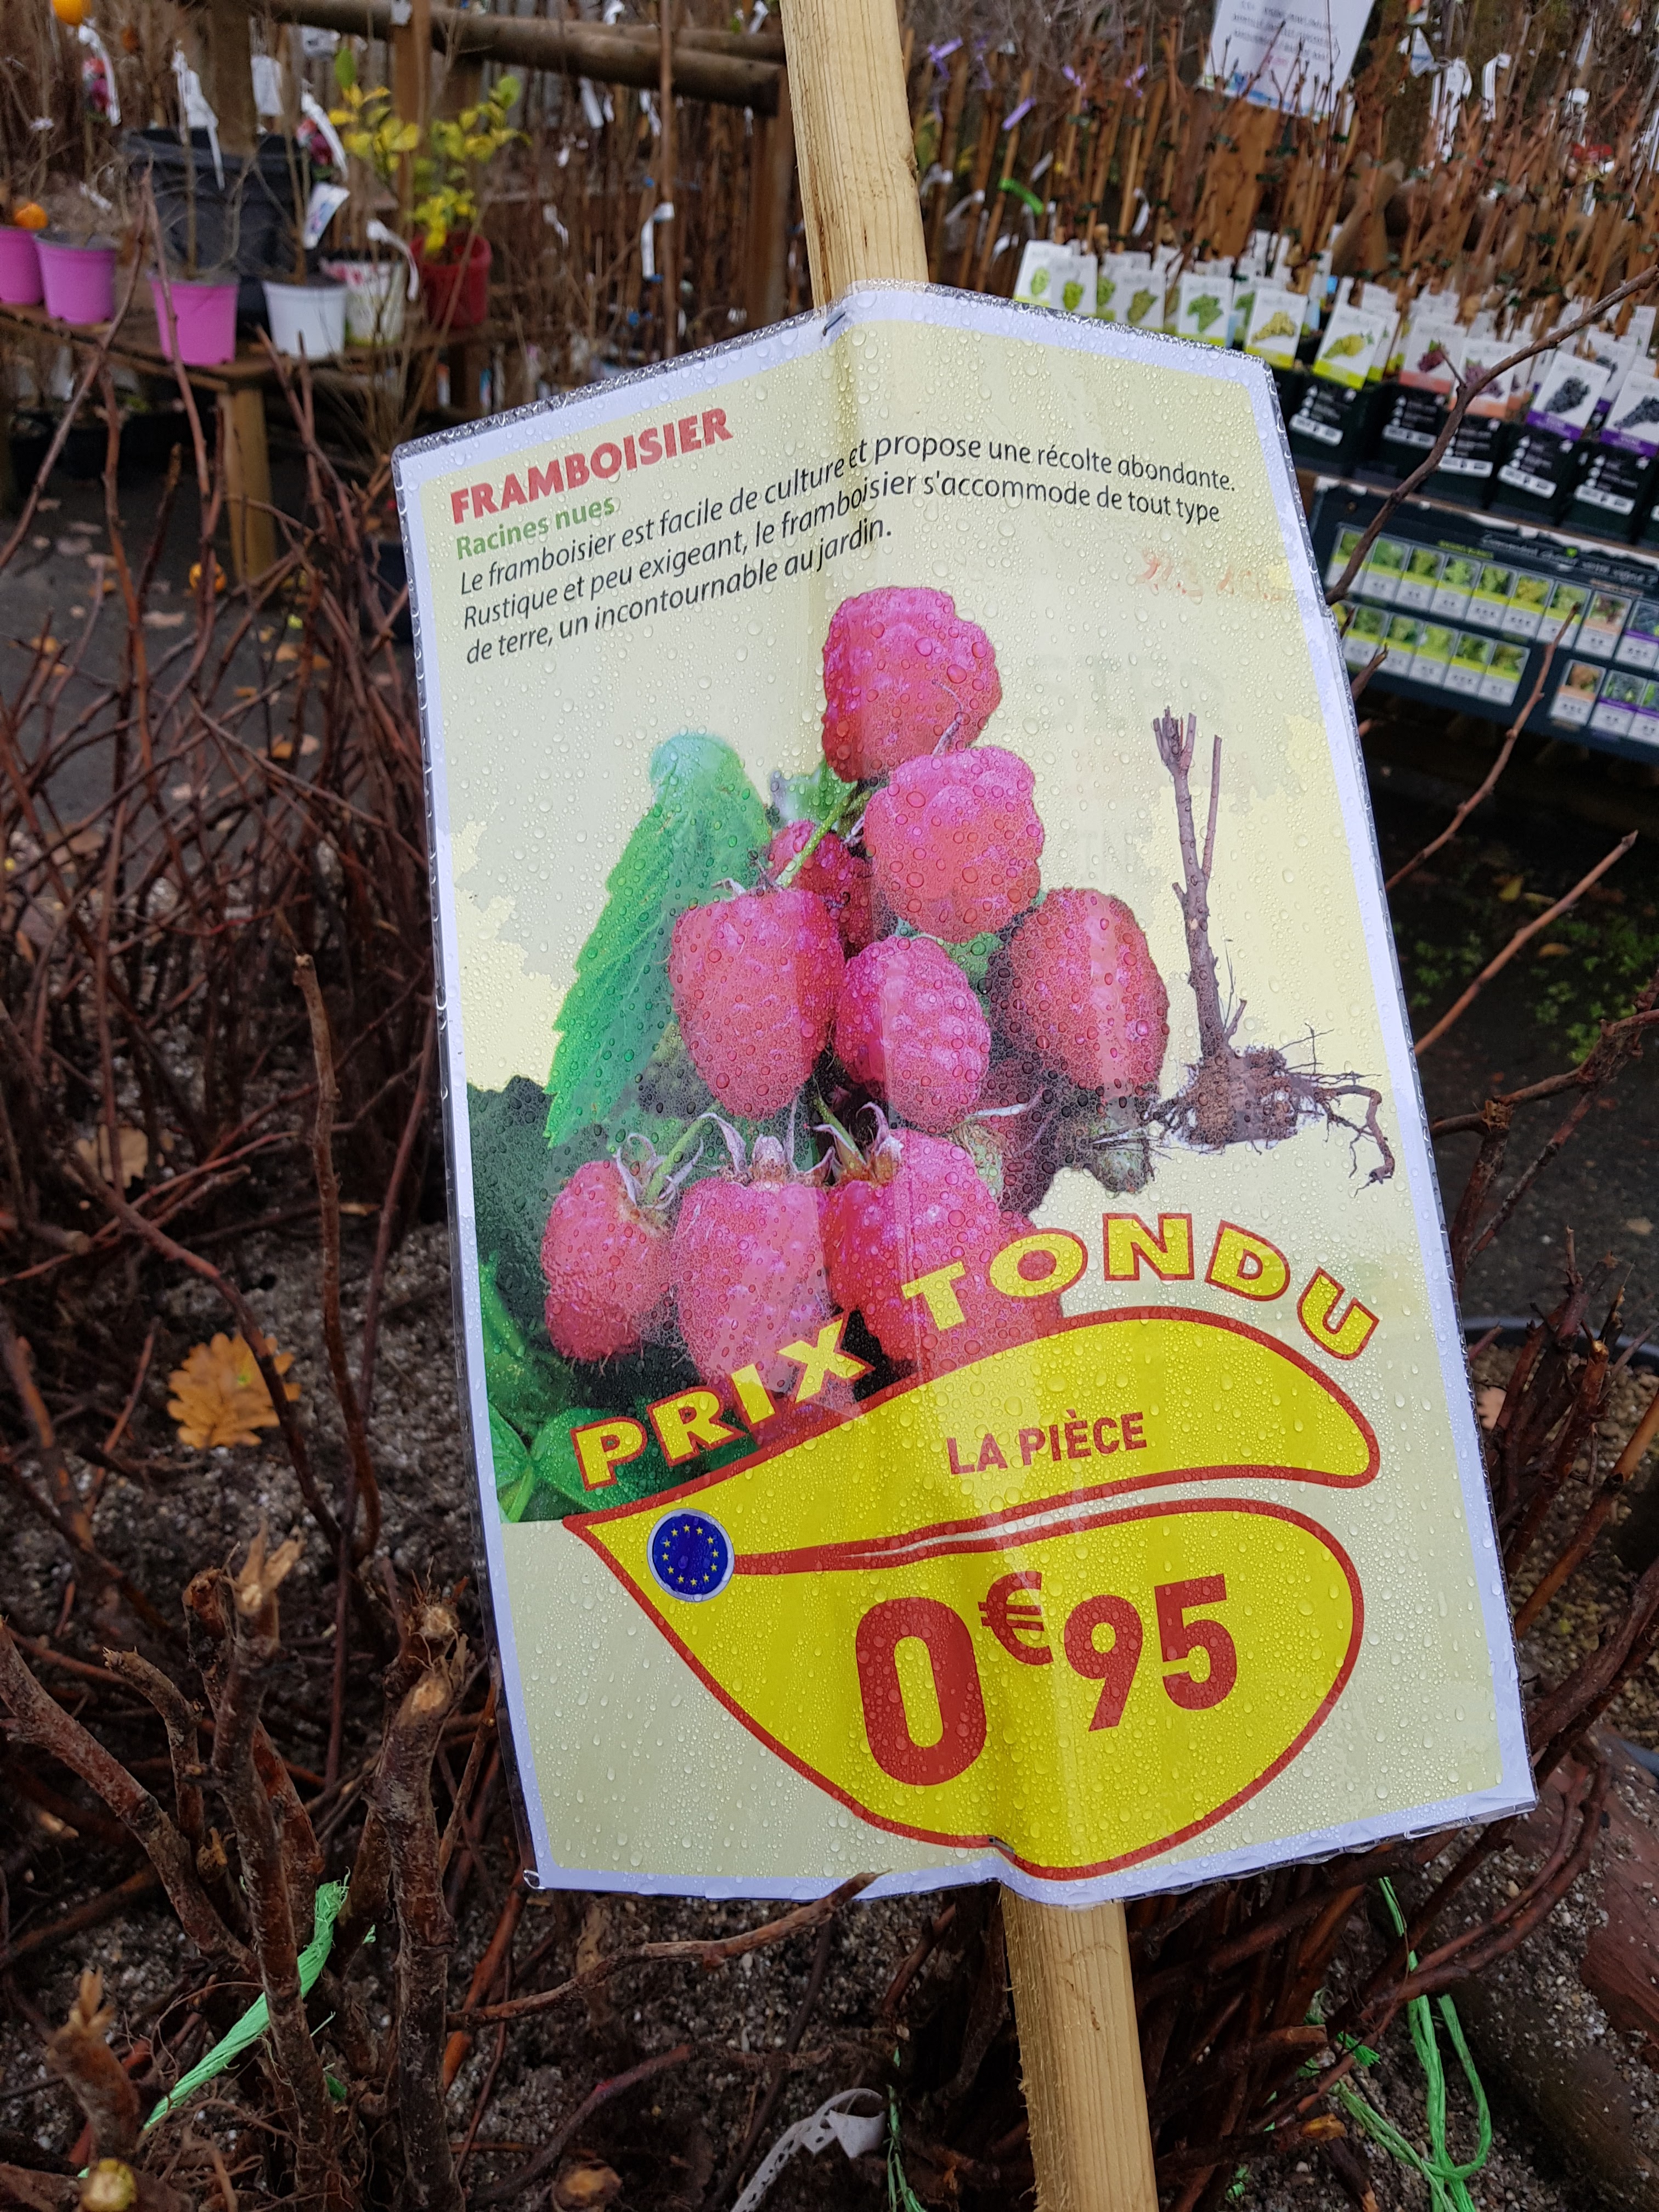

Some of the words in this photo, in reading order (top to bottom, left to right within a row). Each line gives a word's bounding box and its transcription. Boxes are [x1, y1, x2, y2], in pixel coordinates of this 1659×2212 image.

[450, 408, 733, 524] FRAMBOISIER
[456, 515, 549, 560] Racines
[555, 498, 616, 530] nues
[461, 571, 483, 595] Le
[489, 531, 616, 587] framboisier
[622, 518, 654, 548] est
[658, 499, 723, 538] facile
[730, 487, 757, 516] de
[765, 458, 844, 504] culture
[849, 438, 867, 467] et
[874, 435, 981, 465] propose
[989, 442, 1030, 464] une
[1038, 444, 1111, 473] récolte
[1118, 455, 1235, 492] abondante.
[464, 585, 557, 630] Rustique
[564, 577, 584, 602] et
[591, 565, 632, 599] peu
[639, 532, 748, 579] exigeant,
[755, 522, 774, 547] le
[782, 471, 916, 538] framboisier
[924, 471, 1090, 506] s'accommode
[1096, 486, 1122, 511] de
[1128, 492, 1171, 517] tout
[1176, 498, 1221, 525] type
[467, 639, 492, 664] de
[498, 626, 554, 656] terre,
[560, 614, 588, 640] un
[595, 559, 777, 630] incontournable
[785, 549, 812, 576] au
[817, 518, 891, 572] jardin.
[571, 1313, 874, 1491] PRIX
[901, 1211, 1379, 1360] TONDU
[946, 1433, 1008, 1475] LA
[1018, 1408, 1147, 1466] PIÈCE
